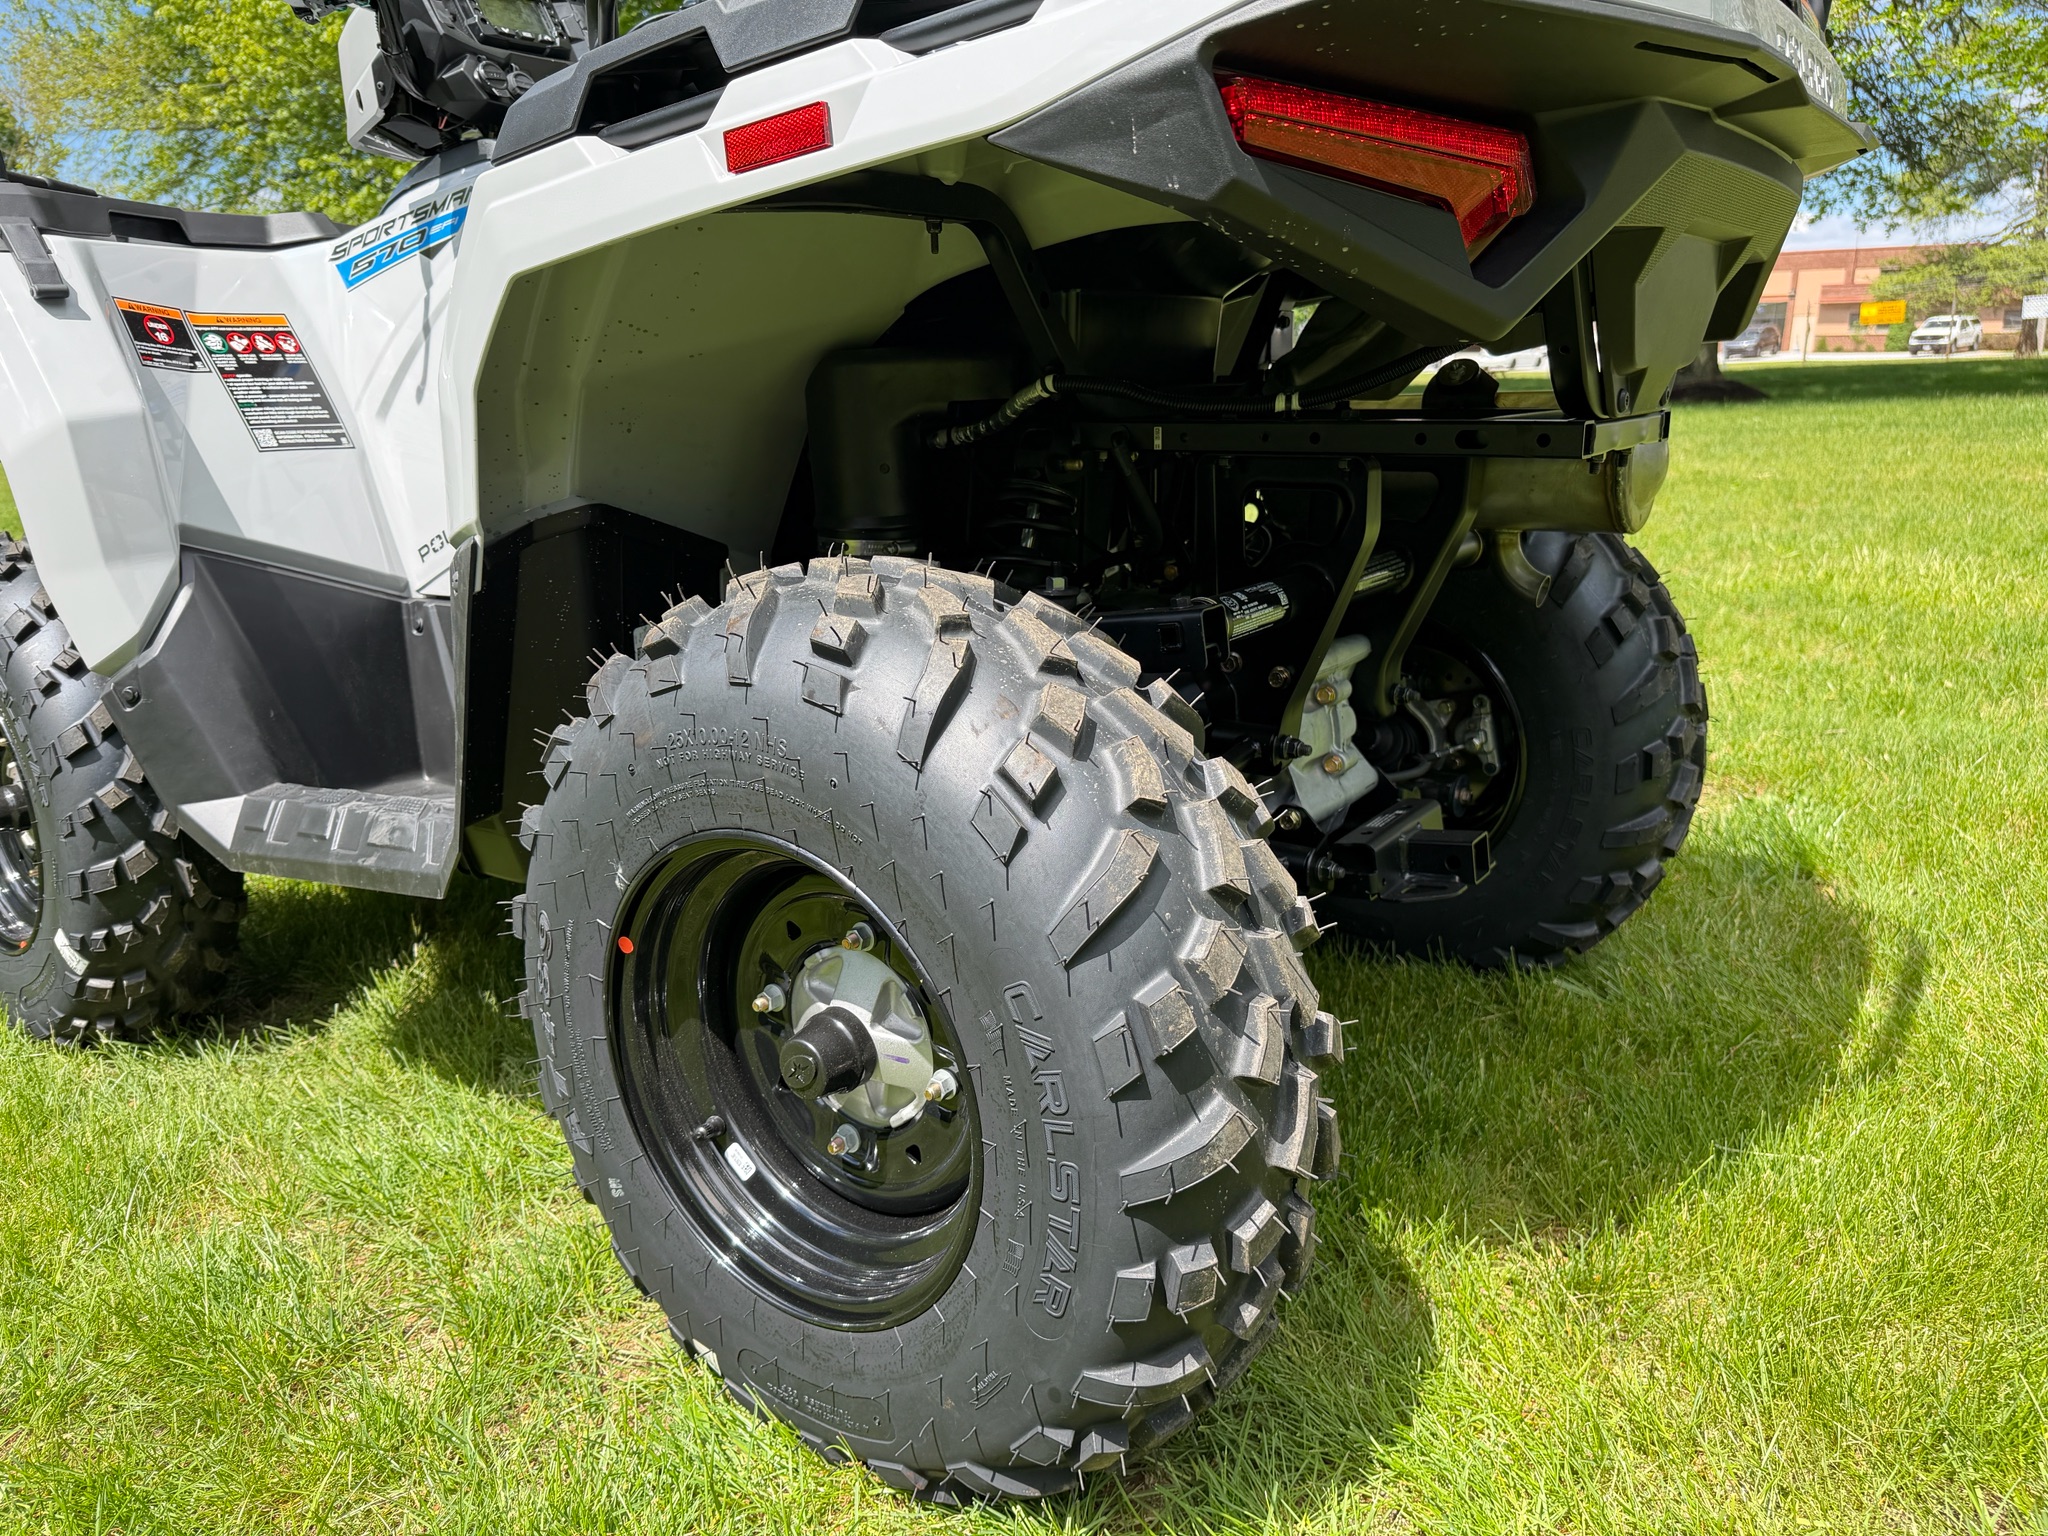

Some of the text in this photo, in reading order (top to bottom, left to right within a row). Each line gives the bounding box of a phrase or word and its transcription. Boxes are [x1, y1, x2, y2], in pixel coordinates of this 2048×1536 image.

[348, 216, 459, 280] 570 EFI
[135, 303, 170, 316] WARNING
[224, 316, 262, 324] WARNING
[154, 331, 170, 342] 16
[754, 731, 788, 758] NHS
[655, 748, 806, 781] NOT FOR HIGHWAY SERVICE
[848, 830, 863, 846] NOT
[1003, 1075, 1019, 1117] MADE
[1013, 1124, 1023, 1140] IN
[1001, 980, 1082, 1319] CARLSTAR
[1016, 1149, 1026, 1177] THE
